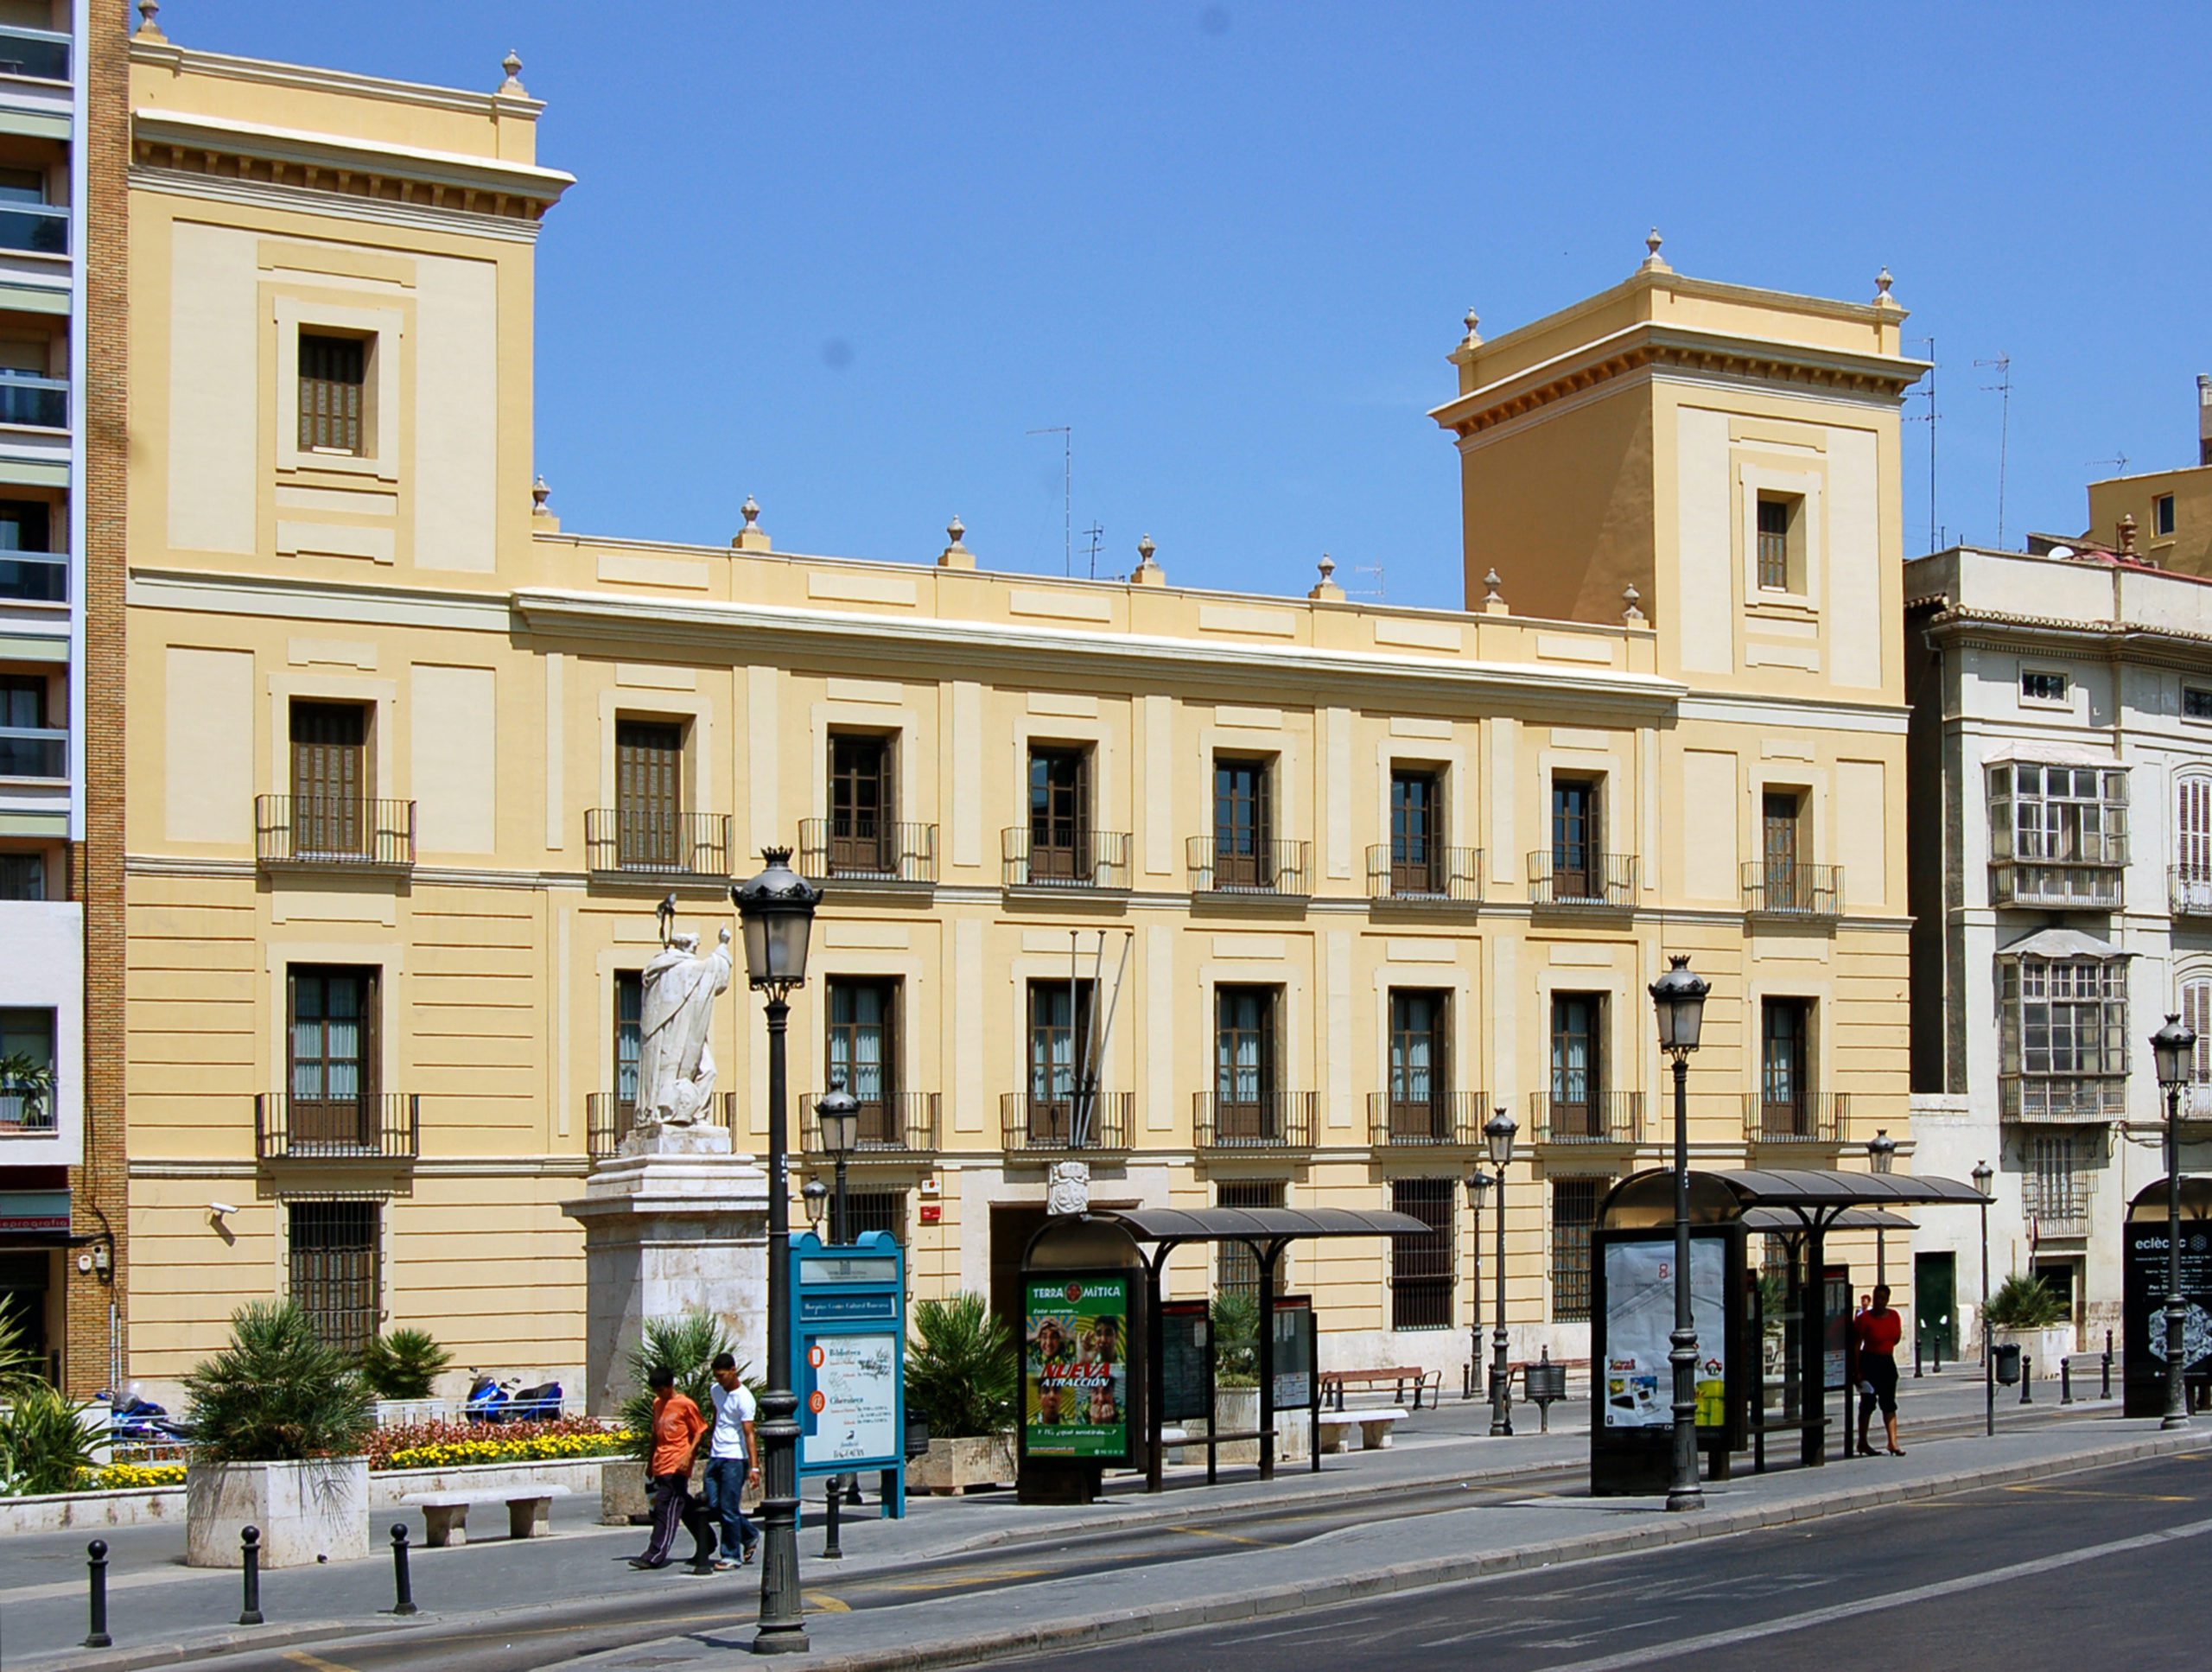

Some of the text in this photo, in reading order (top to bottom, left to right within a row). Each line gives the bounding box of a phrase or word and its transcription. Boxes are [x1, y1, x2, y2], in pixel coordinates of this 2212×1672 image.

[2135, 1237, 2187, 1249] eclècc
[1659, 1263, 1669, 1279] 8
[1033, 1287, 1065, 1299] TERRA
[1039, 1362, 1111, 1379] NUEVA
[1040, 1376, 1110, 1387] ATRACCIÓN
